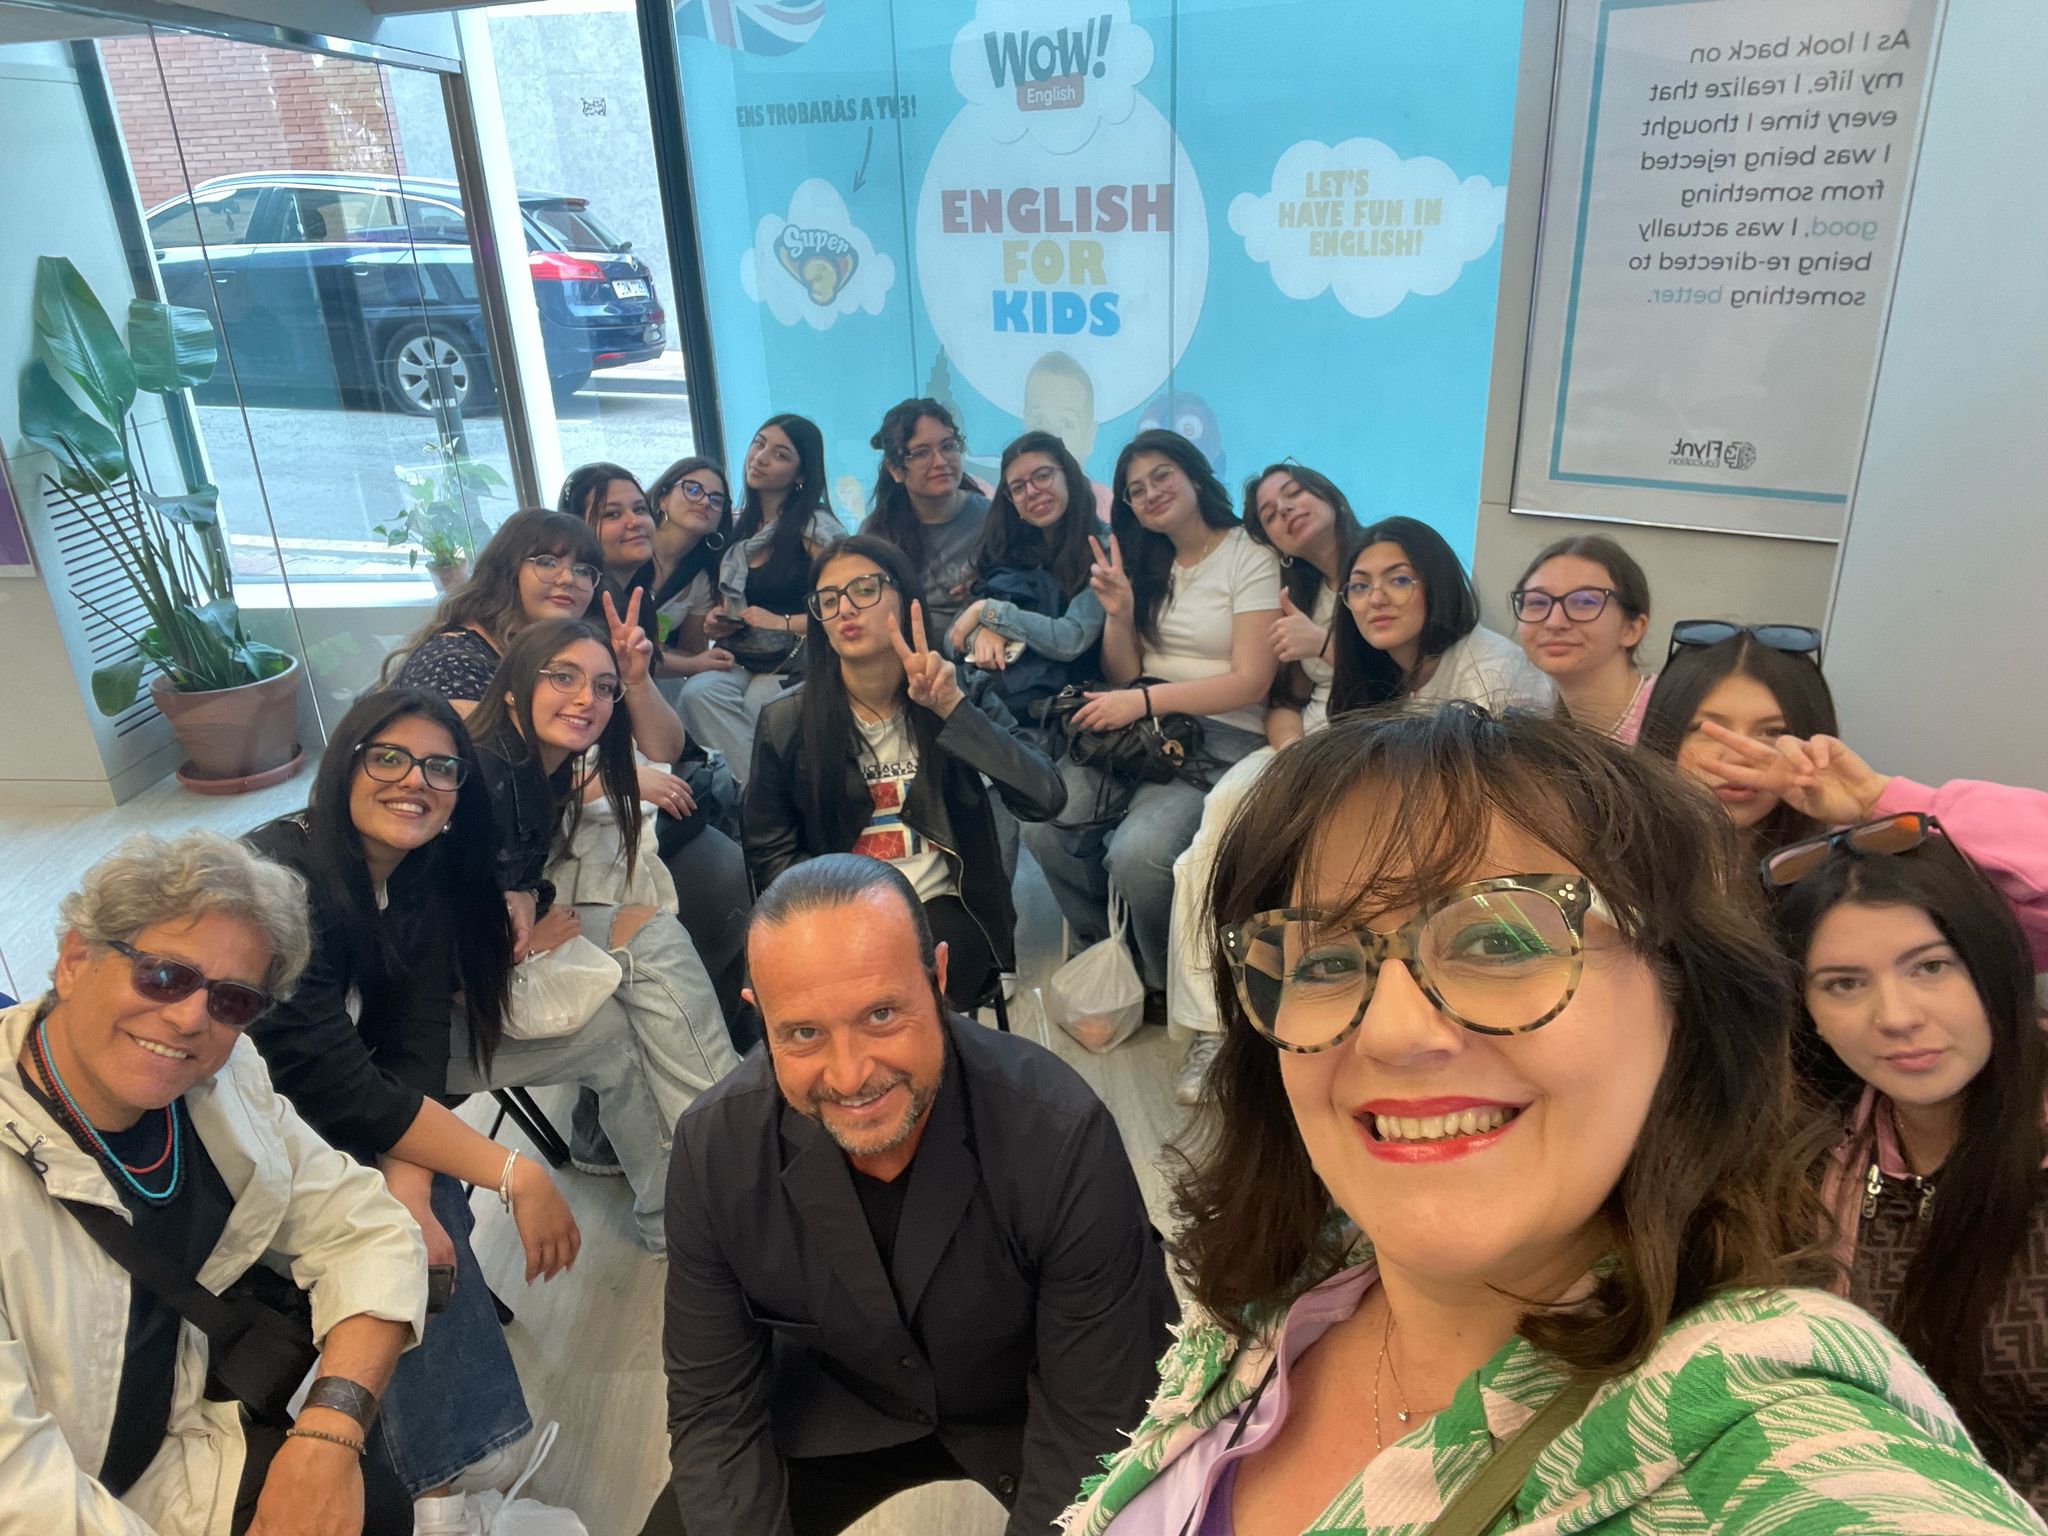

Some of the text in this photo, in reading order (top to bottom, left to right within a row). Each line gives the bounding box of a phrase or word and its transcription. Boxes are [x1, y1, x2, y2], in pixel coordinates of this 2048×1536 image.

[984, 14, 1112, 88] WOW!
[736, 105, 764, 127] ENS
[861, 98, 874, 120] A
[877, 94, 917, 119] TV3!
[1027, 85, 1075, 105] English
[941, 184, 1174, 233] ENGLISH
[1278, 198, 1442, 228] HAVE FUN IN
[1309, 229, 1423, 256] ENGLISH!
[1002, 240, 1106, 285] FOR
[992, 290, 1121, 337] KIDS
